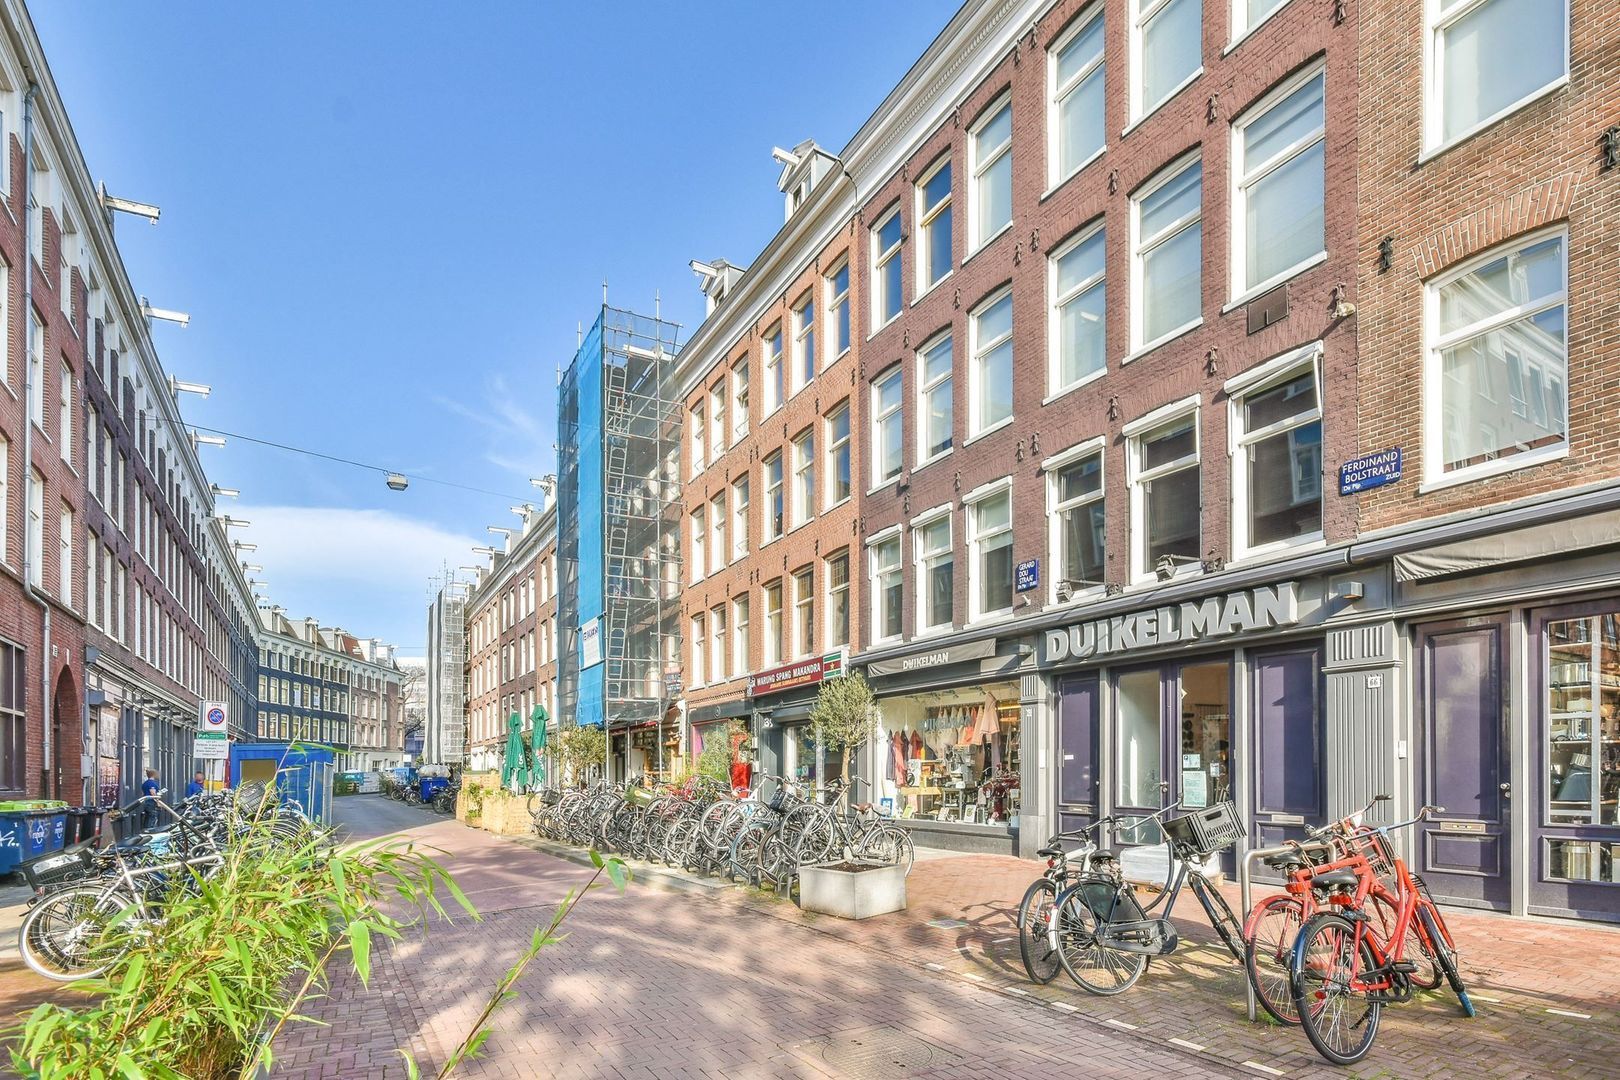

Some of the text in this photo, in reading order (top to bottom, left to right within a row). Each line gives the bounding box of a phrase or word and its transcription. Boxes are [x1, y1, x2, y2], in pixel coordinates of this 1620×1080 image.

[1342, 451, 1398, 474] FERDINAND
[1345, 462, 1397, 484] BOLSTRAAT
[1385, 471, 1401, 480] ZUID
[1018, 560, 1035, 571] GERARD
[1018, 569, 1029, 578] DOU
[1018, 574, 1034, 585] STRAAT
[1045, 581, 1298, 662] DUIKELMAN
[902, 651, 949, 670] DUIKELMAN
[756, 673, 775, 686] WARUNG
[775, 669, 792, 682] SPANG
[792, 662, 821, 678] MAKANDRA
[1369, 678, 1379, 687] 66
